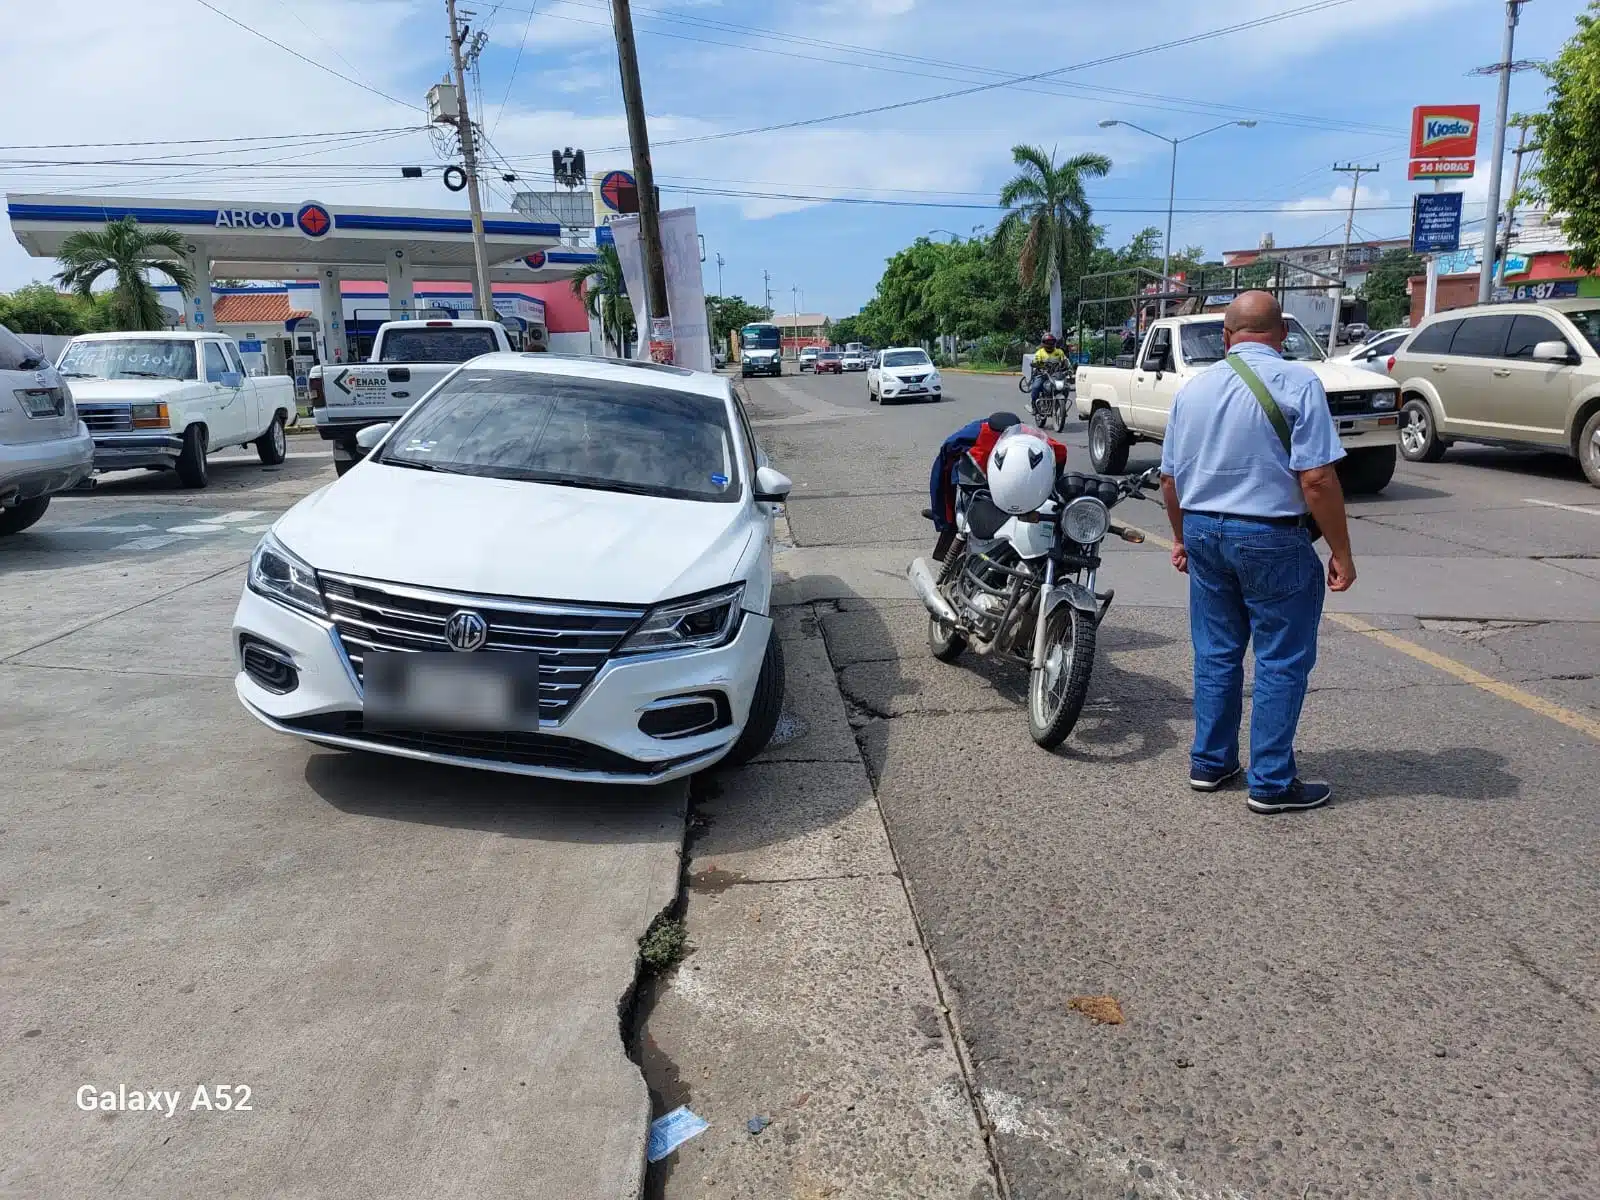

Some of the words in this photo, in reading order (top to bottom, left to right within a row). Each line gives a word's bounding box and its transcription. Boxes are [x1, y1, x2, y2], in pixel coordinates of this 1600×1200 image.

[1426, 120, 1470, 141] Kiosko
[1420, 163, 1434, 173] 24
[1436, 162, 1470, 172] HORAS
[215, 208, 286, 229] ARCO
[1517, 285, 1526, 299] 6
[448, 614, 482, 649] MG
